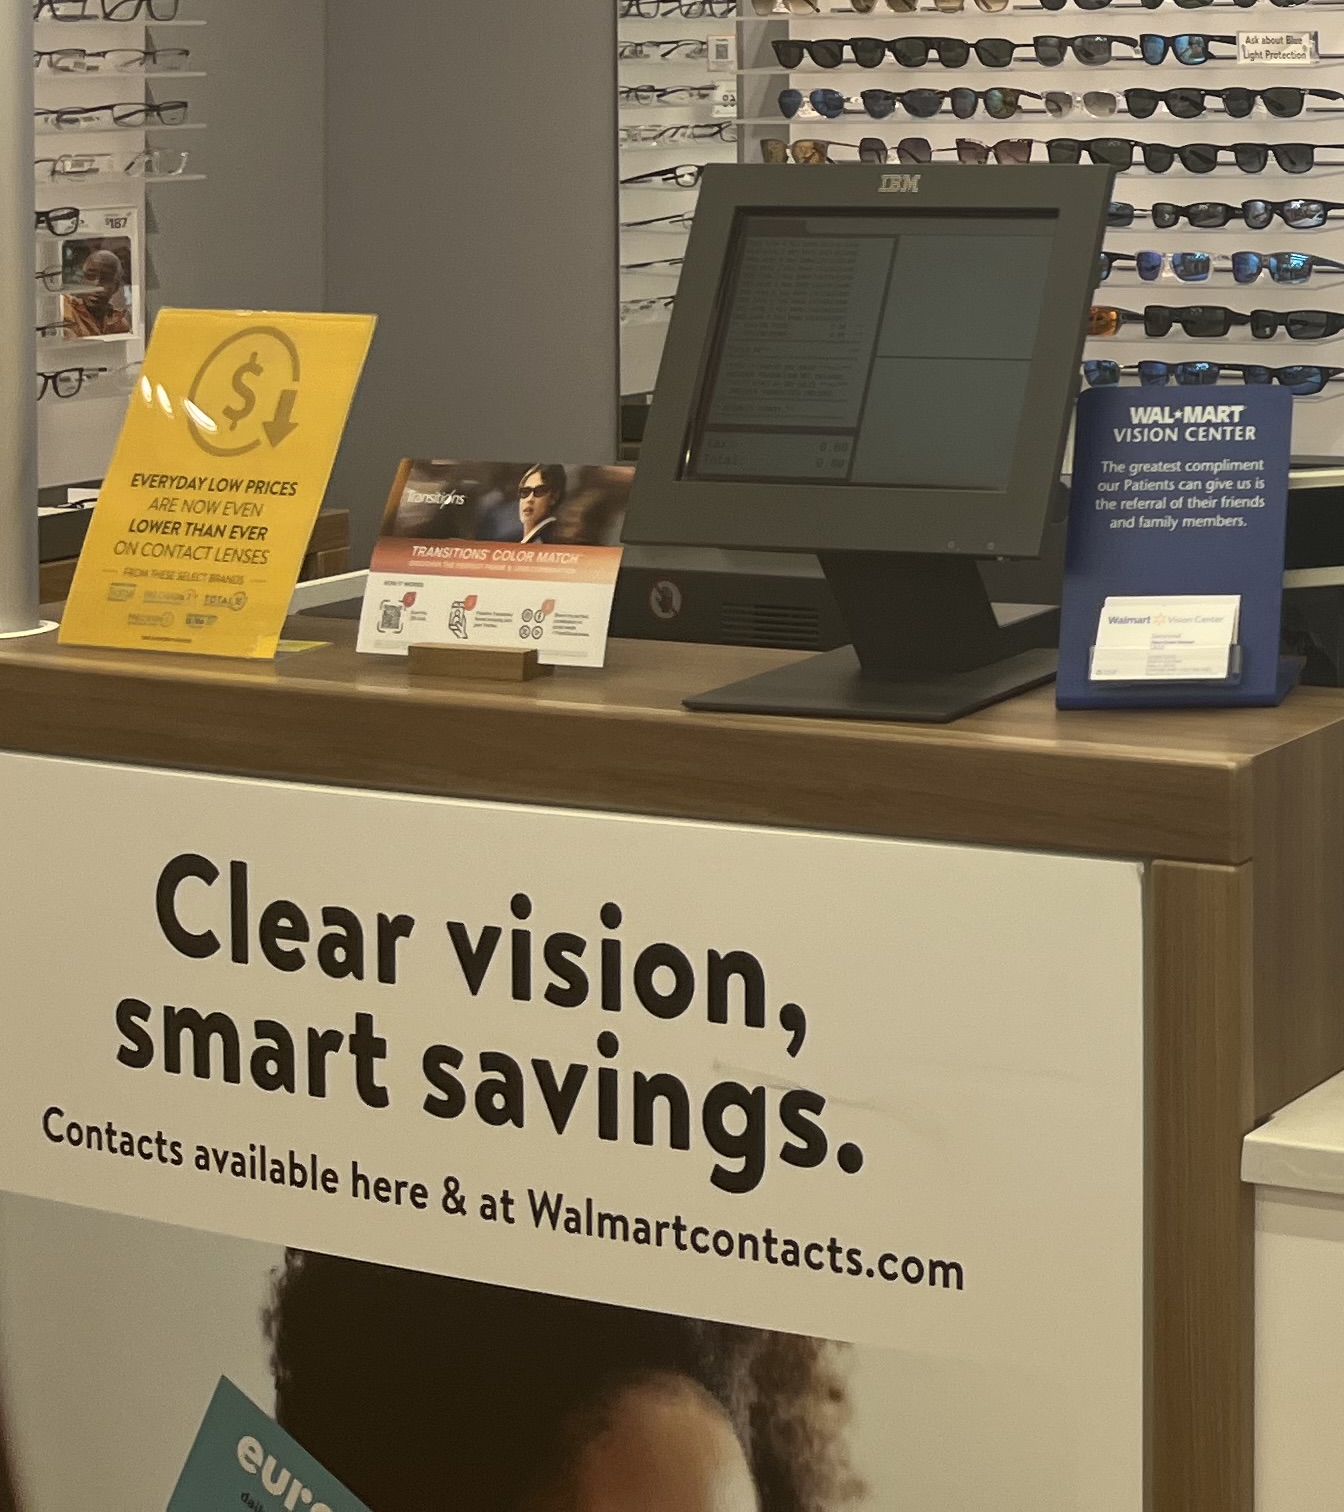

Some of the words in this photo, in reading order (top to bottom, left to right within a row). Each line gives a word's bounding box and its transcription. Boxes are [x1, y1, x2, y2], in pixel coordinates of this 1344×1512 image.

[1246, 36, 1258, 44] Ask
[1262, 36, 1283, 44] about
[1286, 35, 1302, 44] Blue
[1244, 50, 1263, 61] Light
[1266, 50, 1306, 60] Protection
[878, 174, 921, 192] IBM
[1114, 427, 1178, 442] VISION
[1185, 426, 1256, 441] CENTER
[1101, 461, 1125, 473] The
[1130, 461, 1181, 476] greatest
[1185, 459, 1264, 475] compliment
[131, 473, 207, 491] EVERYDAY
[208, 477, 243, 492] LOW
[245, 479, 298, 496] PRICES
[1097, 482, 1120, 491] our
[1124, 479, 1175, 491] Patients
[1179, 481, 1202, 489] can
[1206, 478, 1233, 493] give
[1237, 479, 1251, 489] us
[1255, 477, 1265, 489] is
[148, 497, 179, 512] ARE
[181, 499, 221, 514] NOW
[223, 501, 264, 517] EVEN
[406, 489, 466, 510] Transitions
[1096, 498, 1117, 510] the
[1121, 497, 1166, 509] referral
[1170, 496, 1183, 508] of
[1187, 496, 1217, 508] their
[1221, 495, 1265, 508] friends
[129, 518, 181, 535] LOWER
[185, 522, 227, 538] THAN
[229, 525, 268, 540] EVER
[1110, 516, 1135, 529] and
[1139, 515, 1178, 531] family
[1182, 514, 1247, 527] members.
[114, 541, 139, 555] ON
[141, 542, 213, 560] CONTACT
[214, 547, 269, 564] LENSES
[412, 546, 489, 561] TRANSITIONS
[493, 550, 533, 562] COLOR
[537, 551, 579, 564] MATCH
[1108, 616, 1151, 624] Walmart
[1168, 616, 1192, 624] Vision
[1194, 616, 1224, 624] Center
[155, 853, 415, 985] Clear
[447, 892, 808, 1058] vision,
[115, 995, 390, 1109] smart
[421, 1030, 866, 1195] savings.
[42, 1106, 184, 1167] Contacts
[194, 1137, 340, 1194] available
[350, 1163, 429, 1210] here
[441, 1177, 468, 1216] &
[479, 1189, 516, 1225] at
[528, 1189, 966, 1291] Walmartcontacts.com
[237, 1435, 334, 1512] eur
